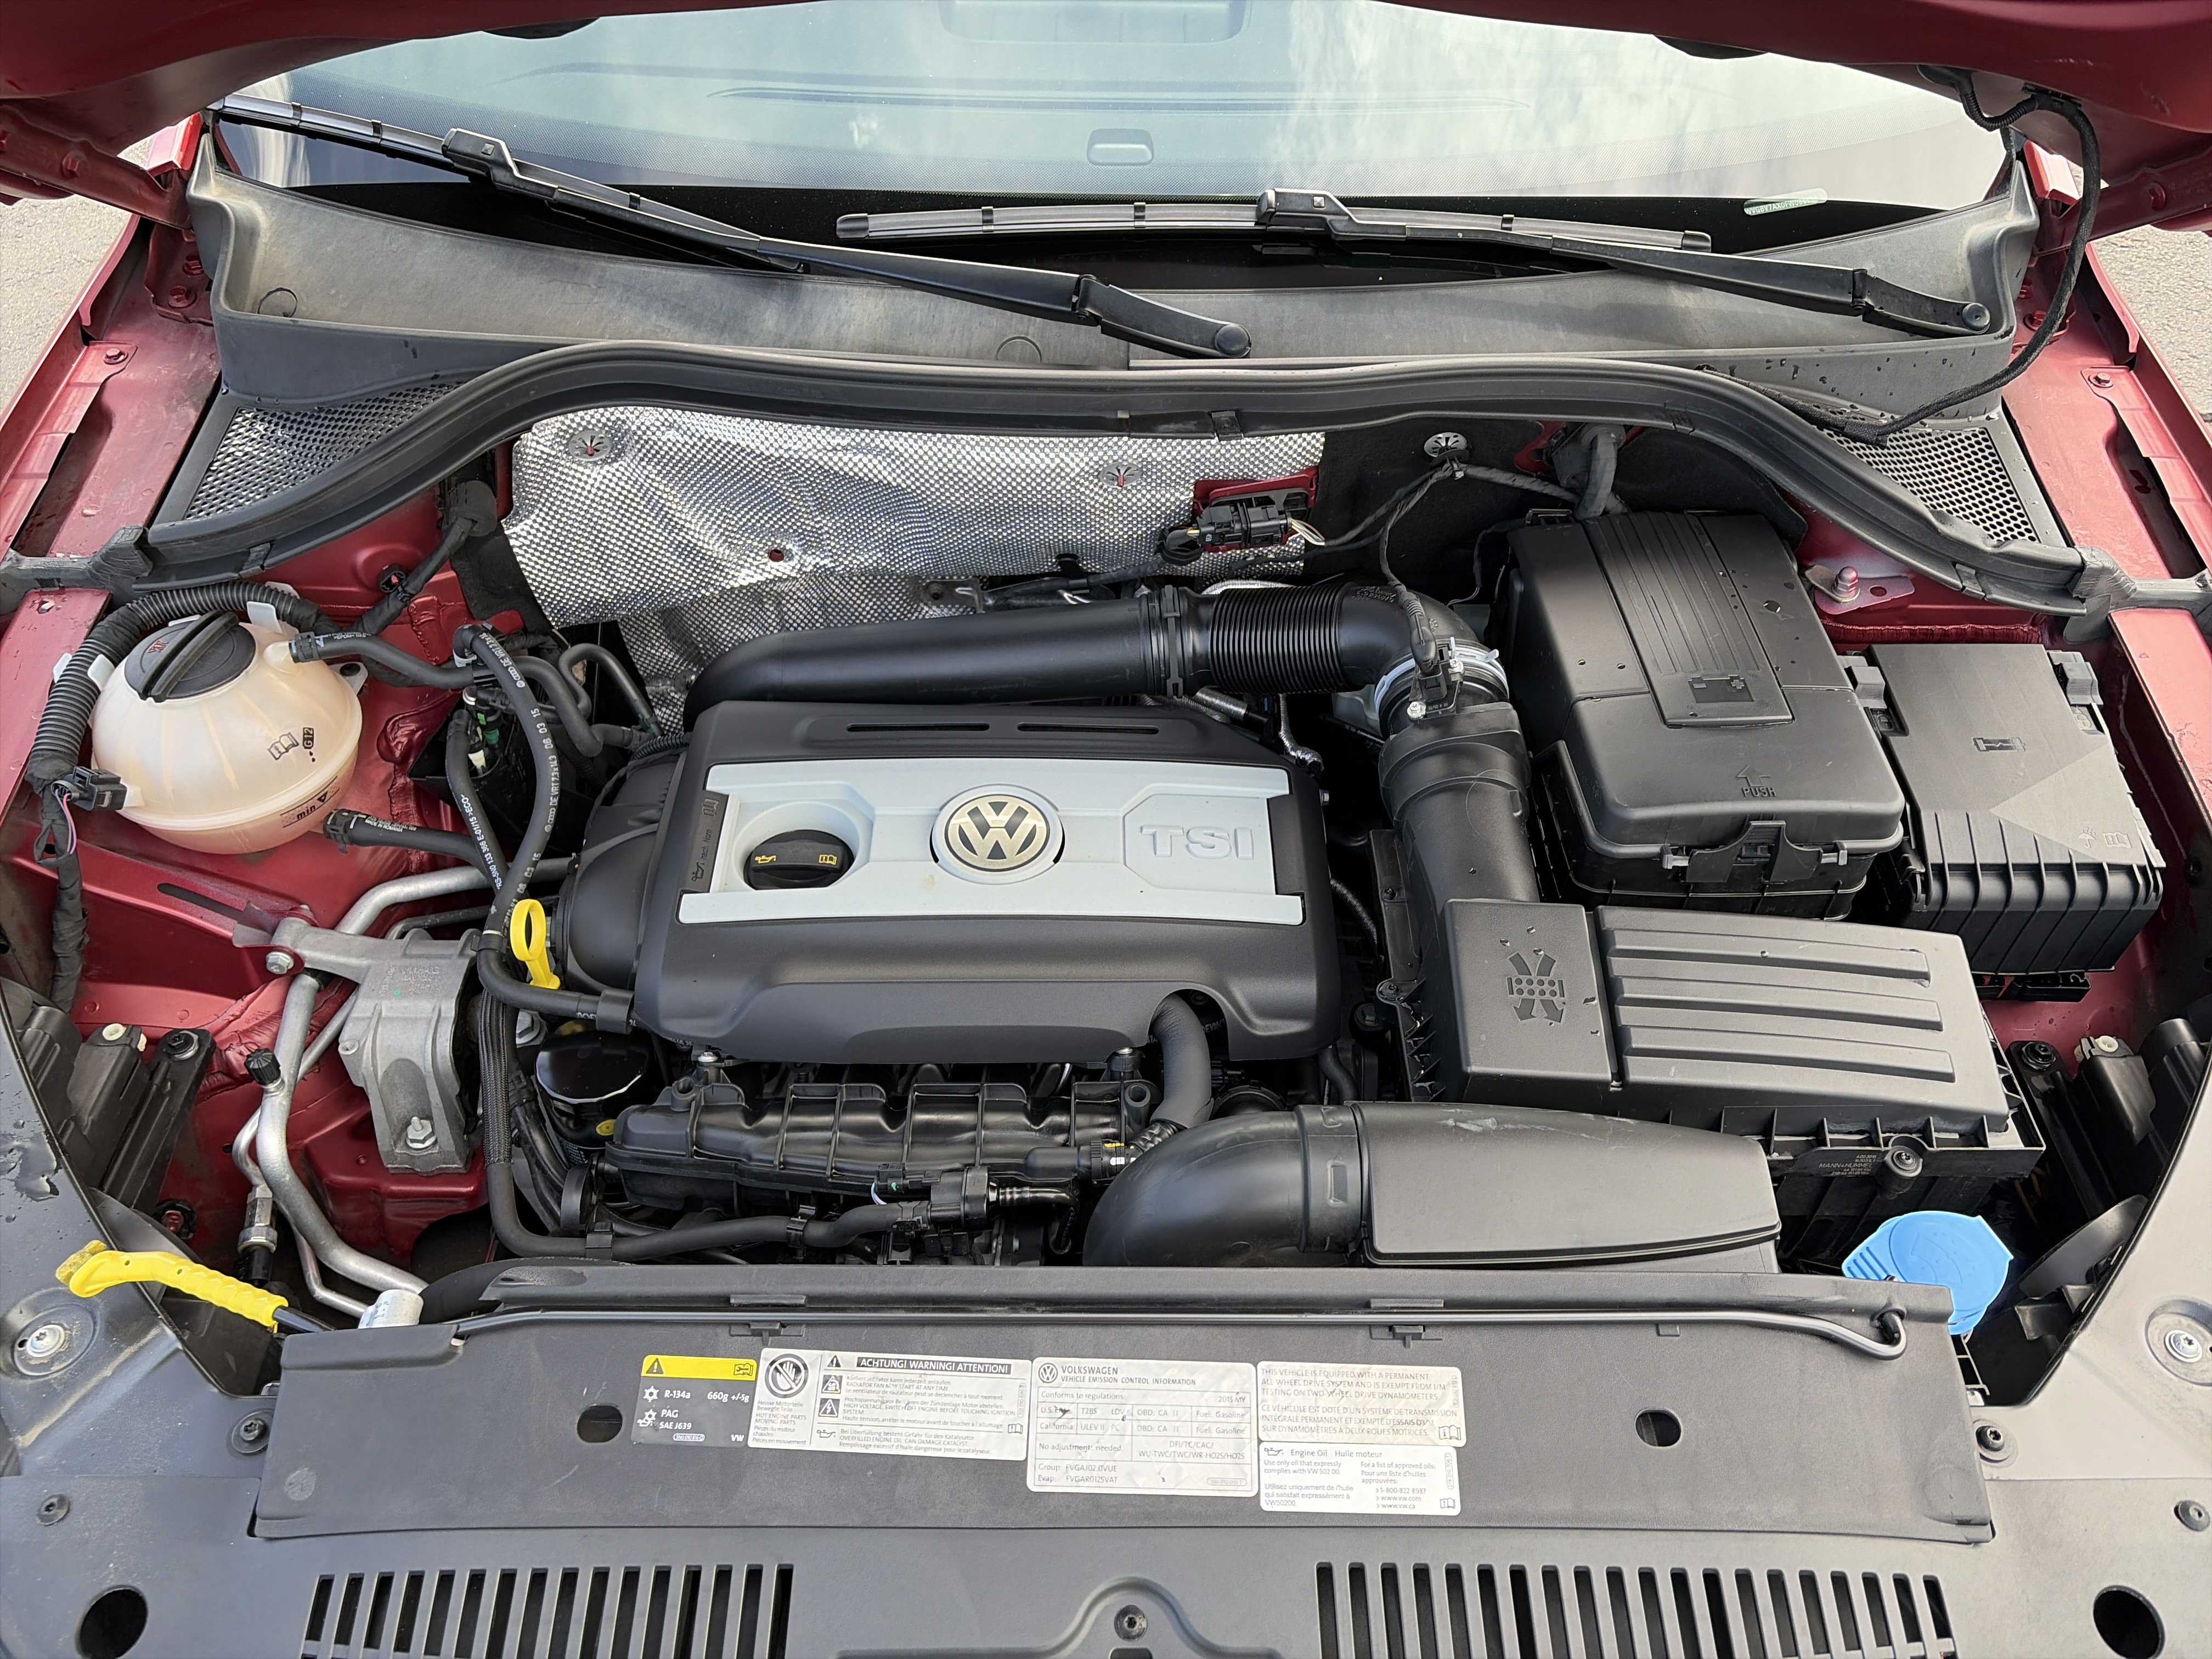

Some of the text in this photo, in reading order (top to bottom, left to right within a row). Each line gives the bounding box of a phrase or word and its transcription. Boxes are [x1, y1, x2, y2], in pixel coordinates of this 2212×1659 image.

[531, 708, 541, 718] 15
[536, 723, 548, 733] 03
[1741, 787, 1777, 797] PUSH
[550, 795, 558, 806] DE
[296, 805, 316, 820] min
[702, 829, 712, 843] Norm
[479, 840, 489, 853] 366
[1140, 825, 1254, 860] TSI
[484, 853, 494, 865] 133
[860, 1358, 1008, 1374] ACHTUNG! WARNING! ATTENTION!
[1062, 1365, 1118, 1375] VOLKSWAGEN
[1319, 1370, 1356, 1378] EQUIPPED
[1385, 1372, 1429, 1380] PERMANENT
[664, 1390, 750, 1403] R-134a 660g +/-5g
[1262, 1388, 1291, 1396] TESTING
[661, 1409, 679, 1418] PAG
[1404, 1409, 1457, 1417] TRANSMISSION
[1301, 1415, 1343, 1424] PERMANENT
[1291, 1449, 1316, 1458] Engine
[1277, 1459, 1290, 1468] only
